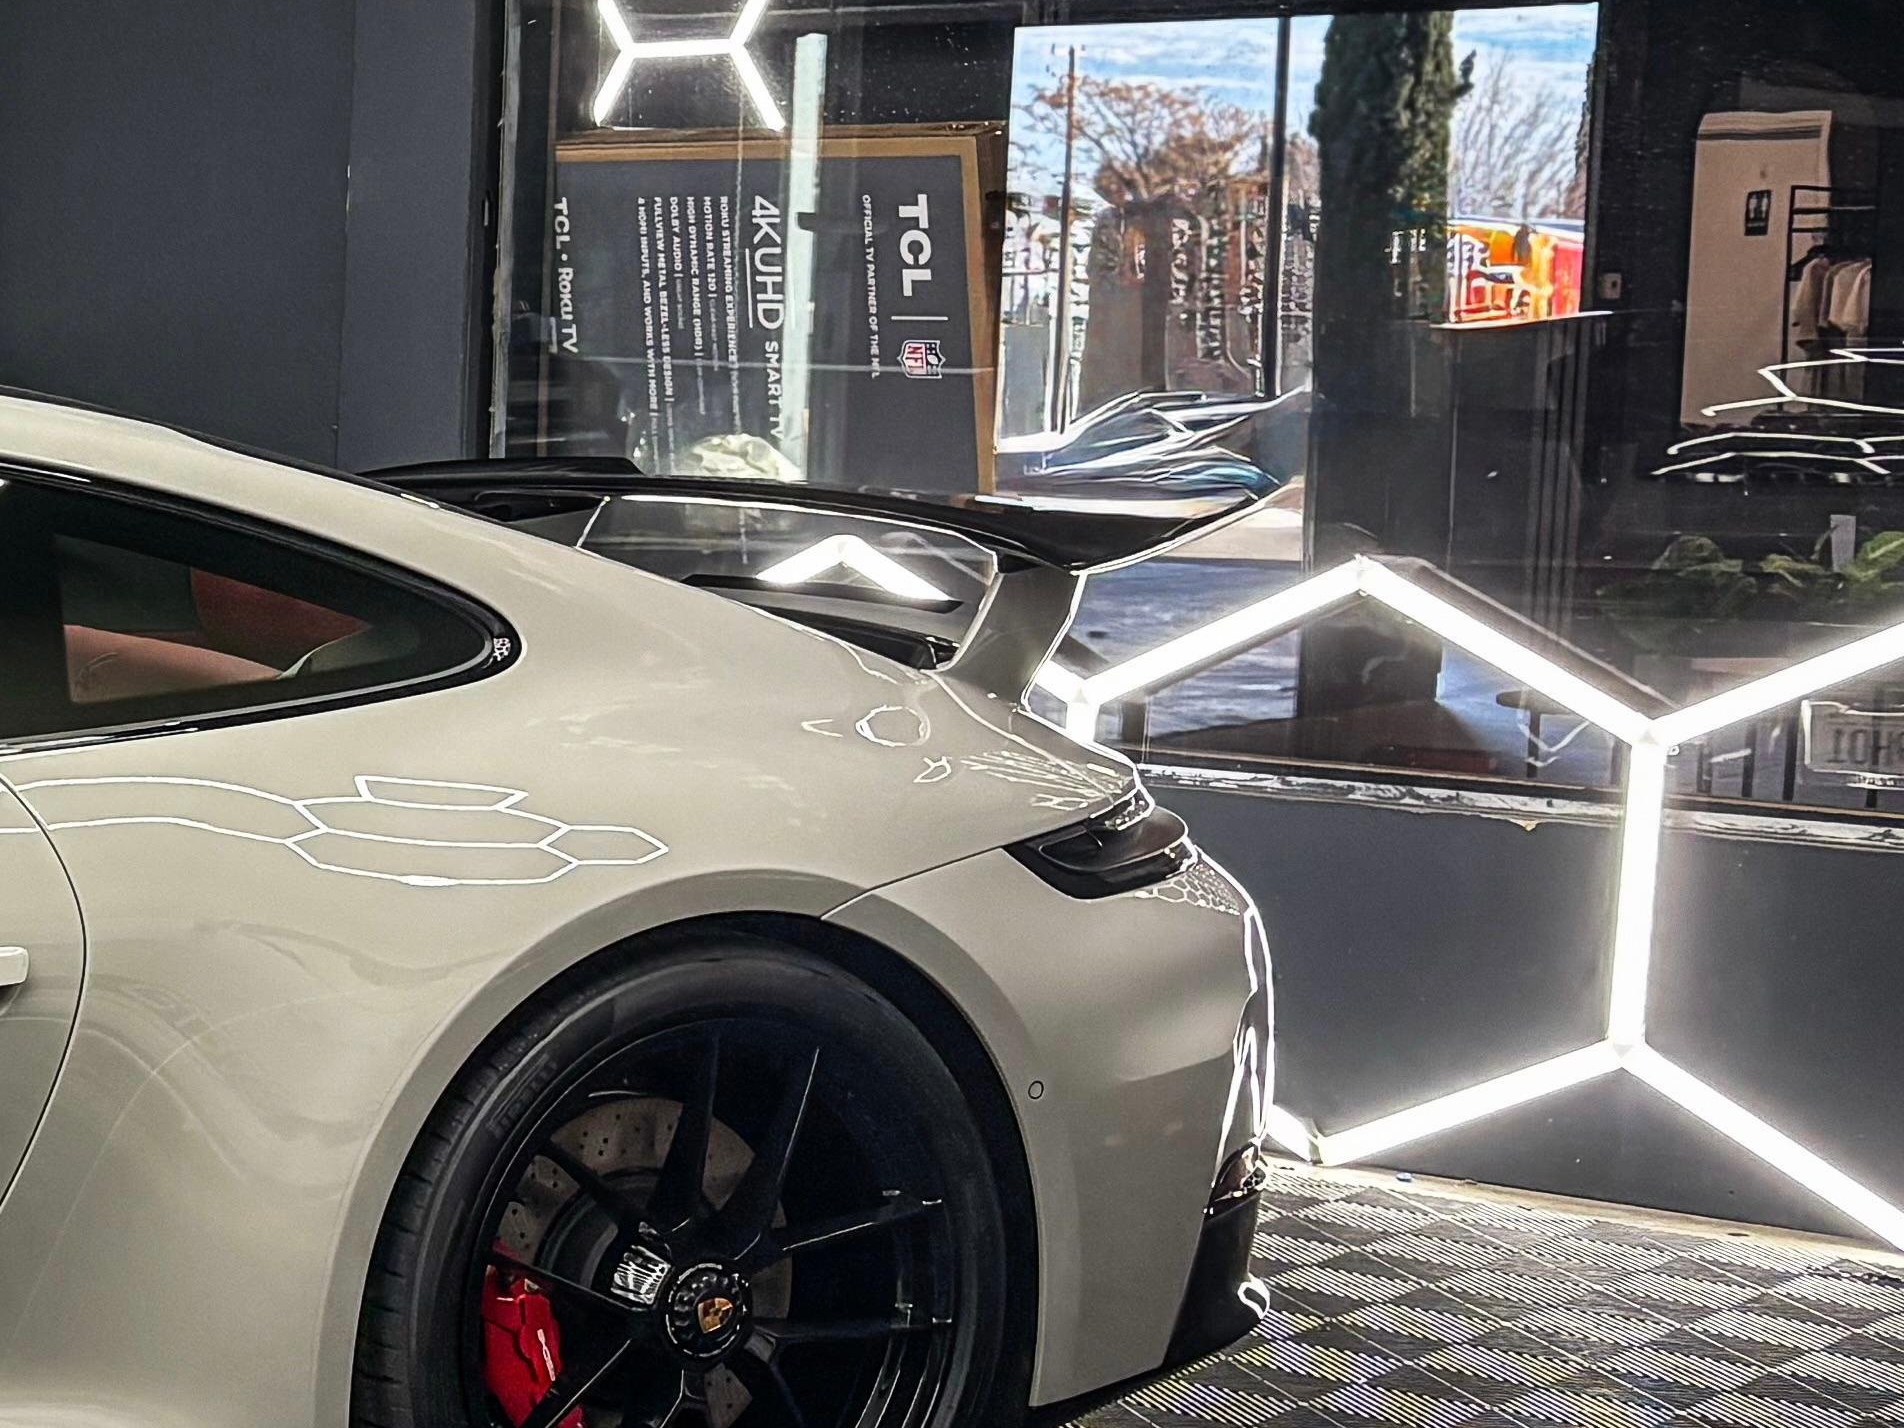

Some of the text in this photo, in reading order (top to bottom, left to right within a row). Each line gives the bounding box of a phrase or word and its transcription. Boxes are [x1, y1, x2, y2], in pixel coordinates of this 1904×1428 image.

[670, 196, 680, 233] DOLBY
[687, 196, 697, 223] HIGH
[704, 196, 714, 240] MOTION
[862, 194, 874, 245] OFFICIAL
[672, 235, 682, 271] AUDIO
[688, 225, 699, 275] DYNAMIC
[705, 242, 715, 270] RATE
[722, 229, 733, 293] STREAMING
[865, 246, 875, 262] TV
[898, 193, 932, 297] TCL
[554, 197, 579, 353] TCL Roku TV
[657, 253, 667, 288] METAL
[866, 263, 878, 314] PARTNER
[643, 280, 652, 304] AND
[691, 278, 702, 316] RANGE
[644, 306, 654, 347] WORKS
[868, 315, 879, 332] OF
[870, 334, 880, 357] THE
[764, 341, 783, 410] SMART
[648, 379, 658, 410] MORE
